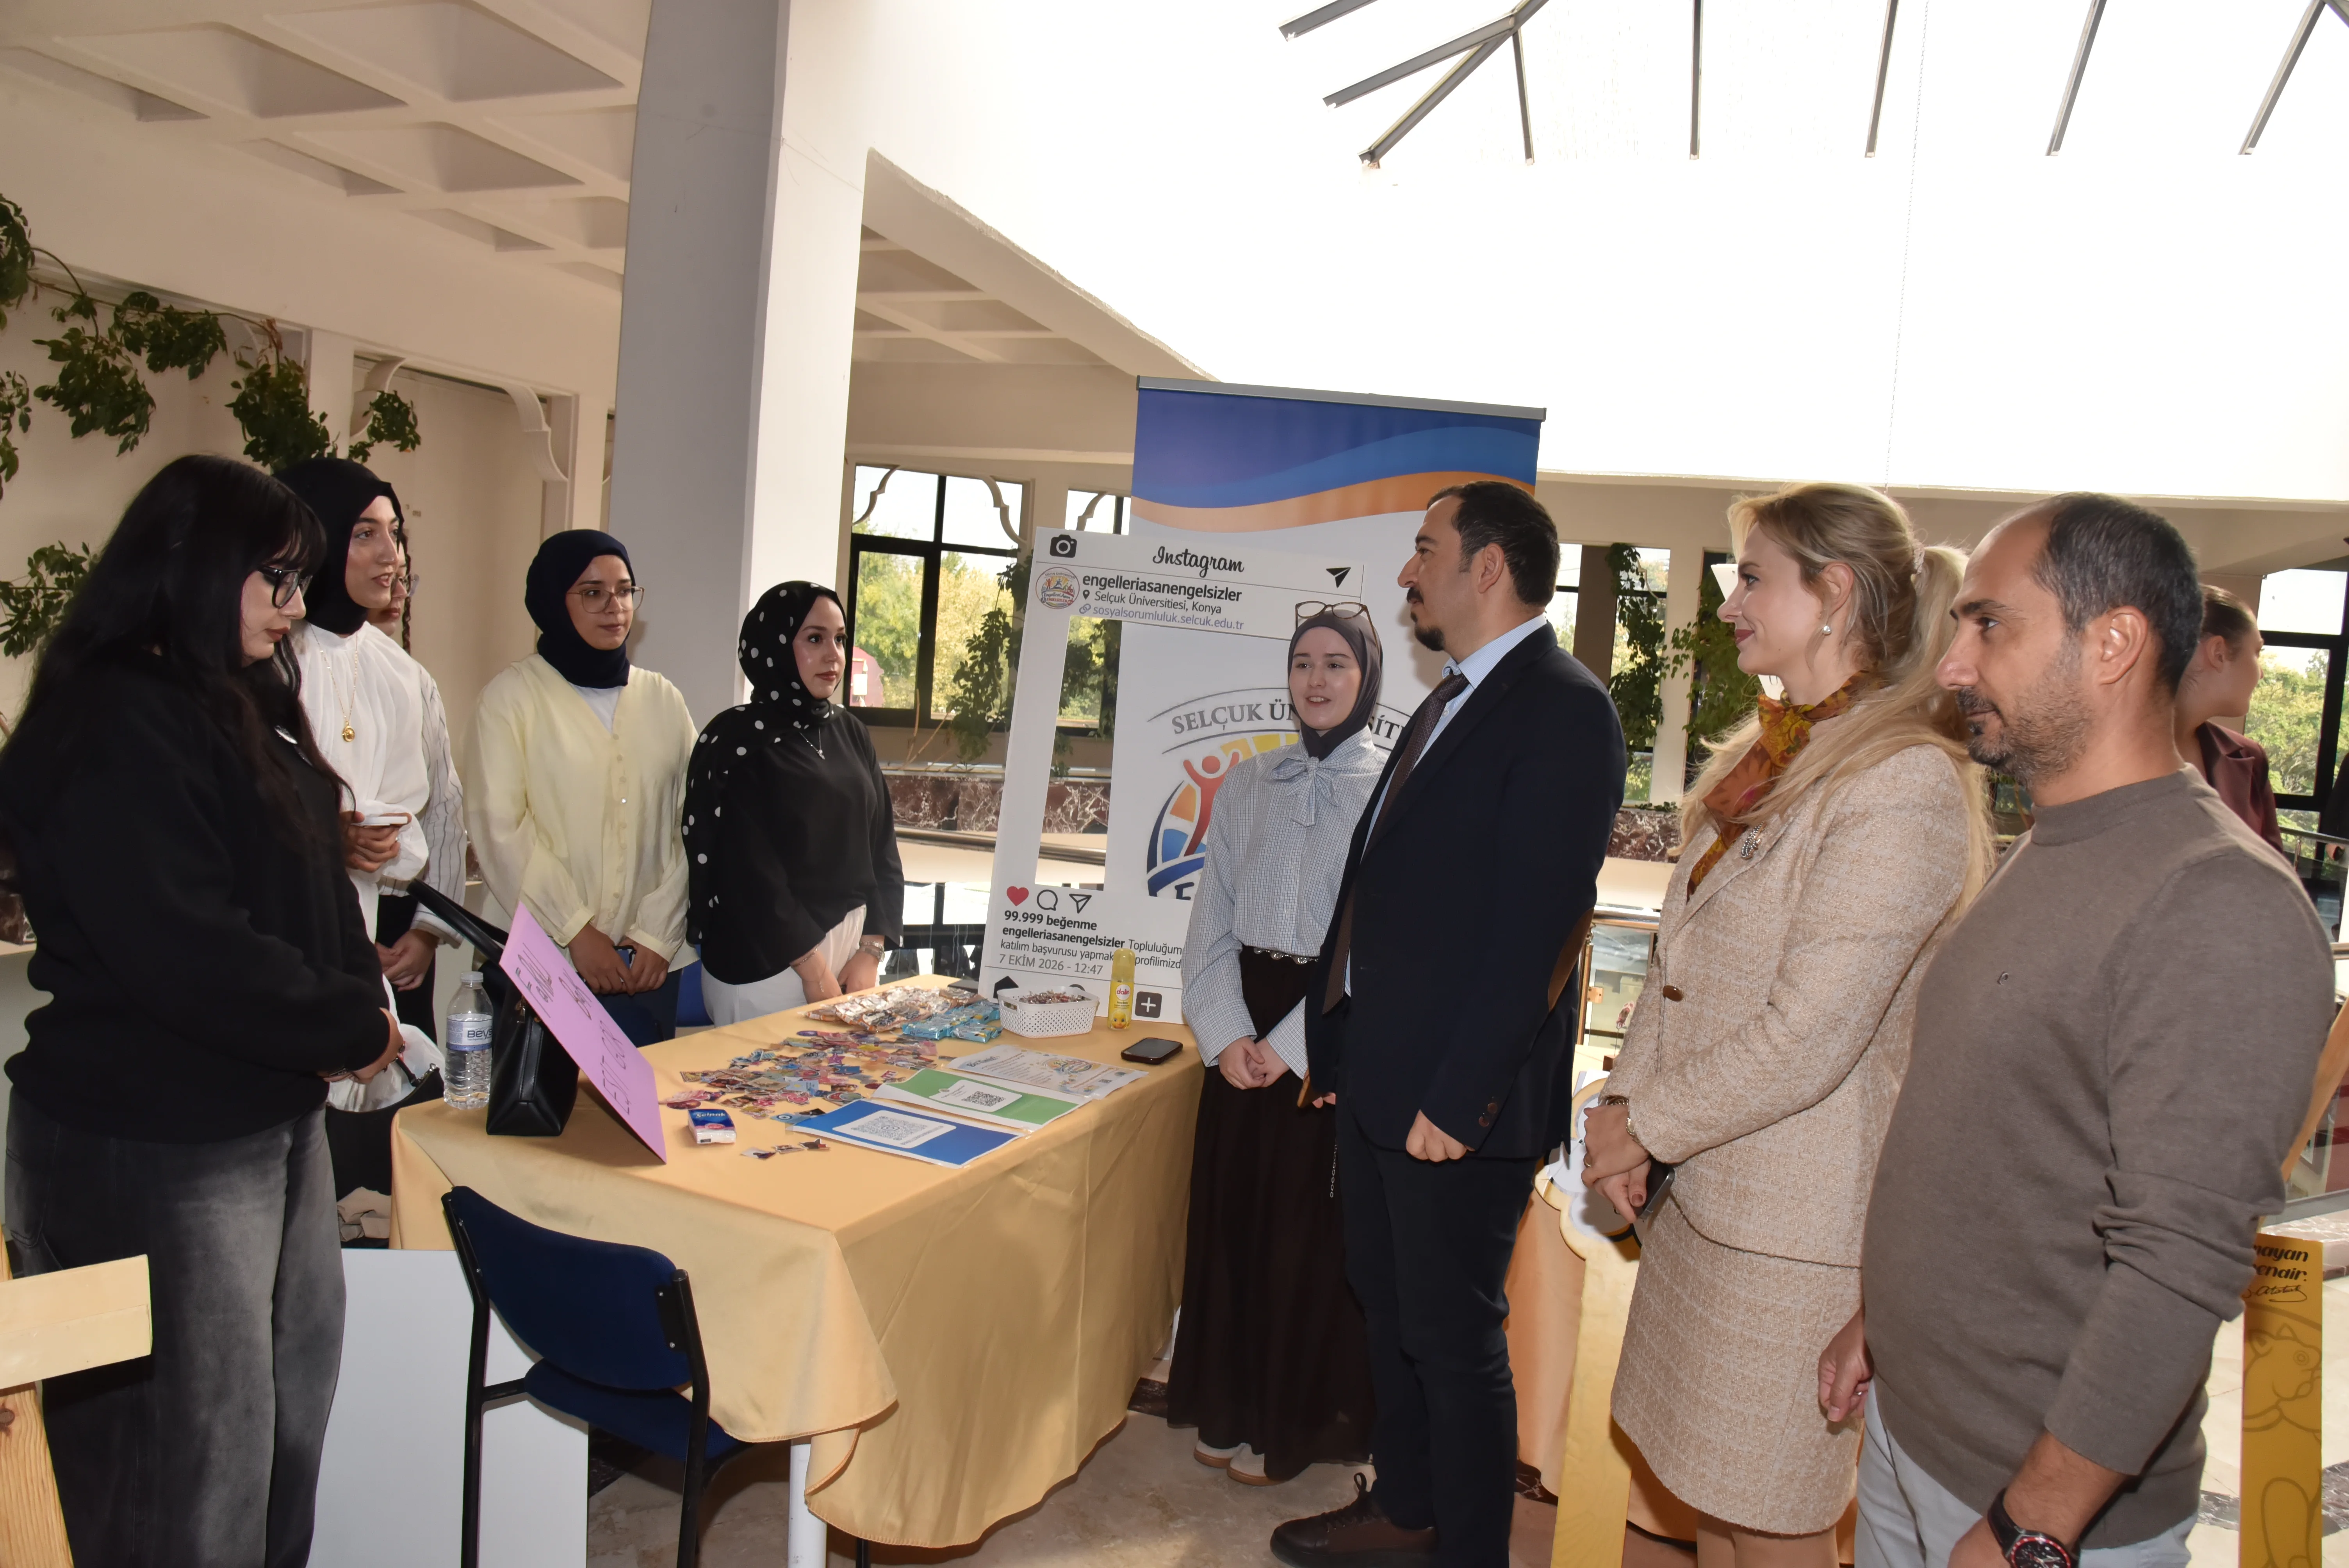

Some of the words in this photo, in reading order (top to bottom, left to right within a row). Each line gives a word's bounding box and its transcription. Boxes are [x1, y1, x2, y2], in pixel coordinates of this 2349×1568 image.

[1152, 546, 1245, 578] Instagram
[1082, 573, 1242, 602] engelleriasanengelsizler
[1094, 591, 1126, 604] Selçuk
[1192, 601, 1222, 615] Konya
[1093, 606, 1244, 630] sosyalsorumluluk.selcuk.edu.tr
[1172, 703, 1264, 735] SELÇUK
[1004, 910, 1043, 924] 99.999
[1046, 915, 1097, 930] beğenme
[1002, 927, 1125, 948] engelleriasanengelsizler
[1000, 939, 1029, 951] katılım
[1032, 943, 1077, 957] başvurusu
[1080, 950, 1114, 961] yapmak
[999, 953, 1006, 964] 7
[1008, 954, 1036, 968] EKİM
[1038, 959, 1064, 971] 2026
[1074, 962, 1103, 975] 12:47
